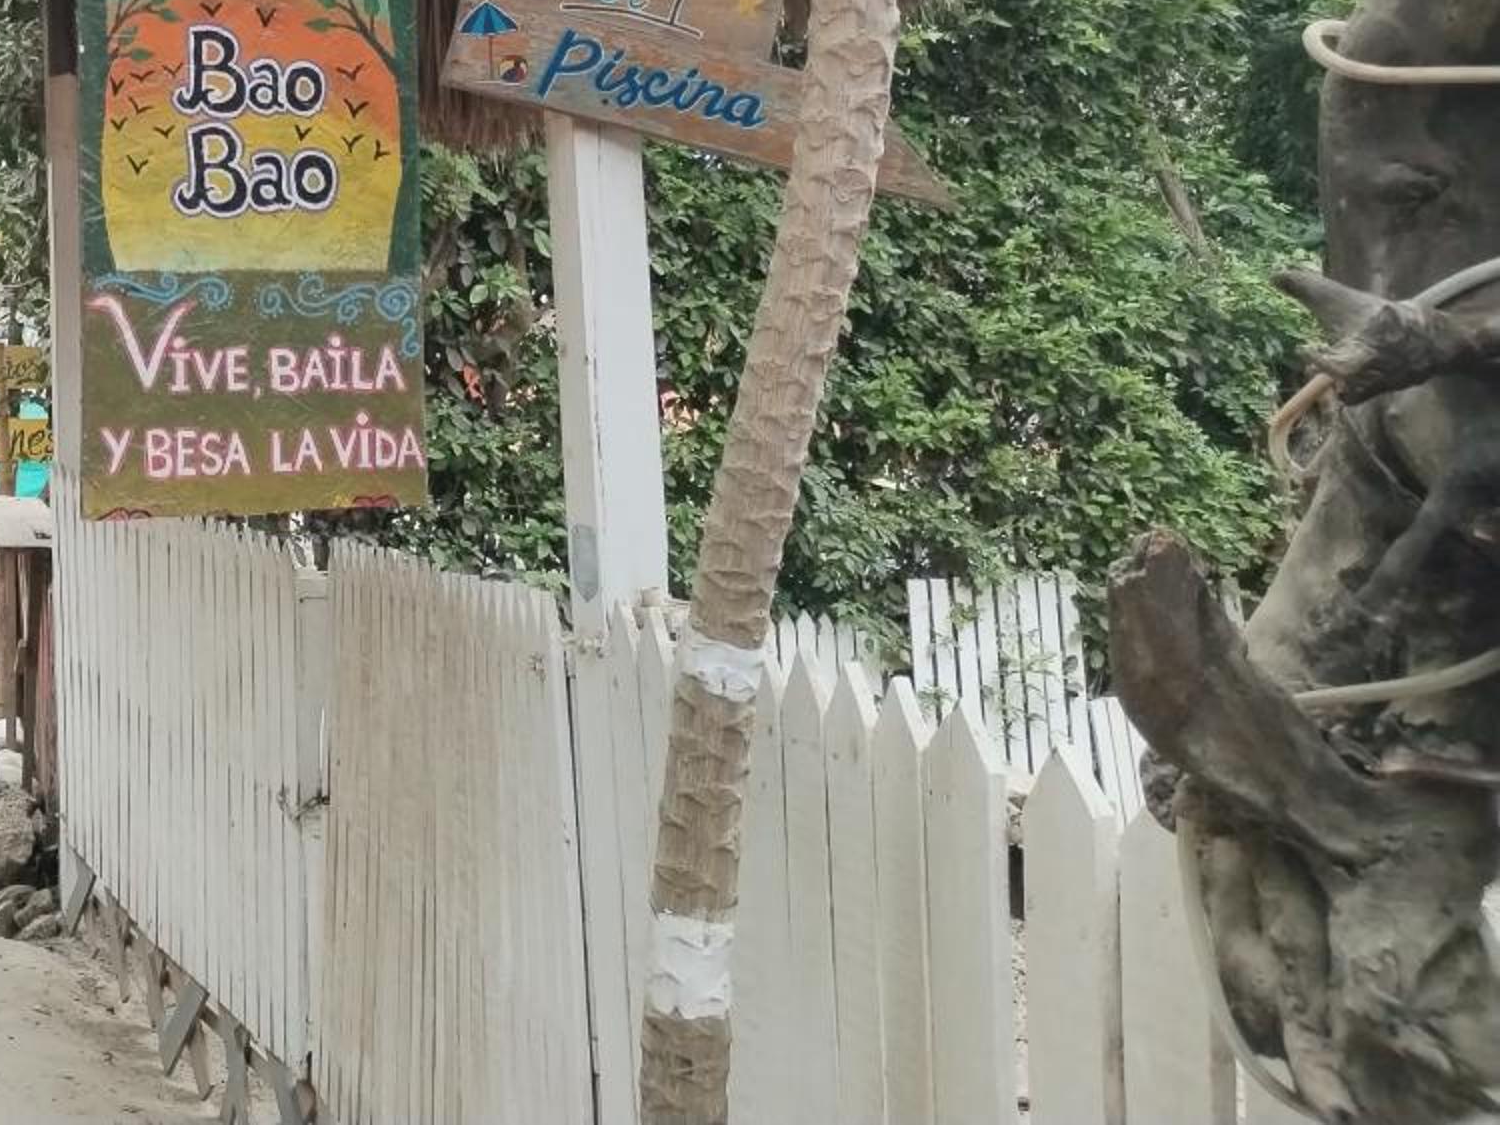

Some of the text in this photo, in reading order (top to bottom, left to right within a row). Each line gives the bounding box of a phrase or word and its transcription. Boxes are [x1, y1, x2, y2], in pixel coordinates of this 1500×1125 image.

[171, 23, 329, 119] Bao
[537, 27, 767, 129] Piscina
[171, 119, 341, 219] Bao
[268, 335, 407, 393] BAILA
[100, 410, 428, 479] Y BESA LA VIDA
